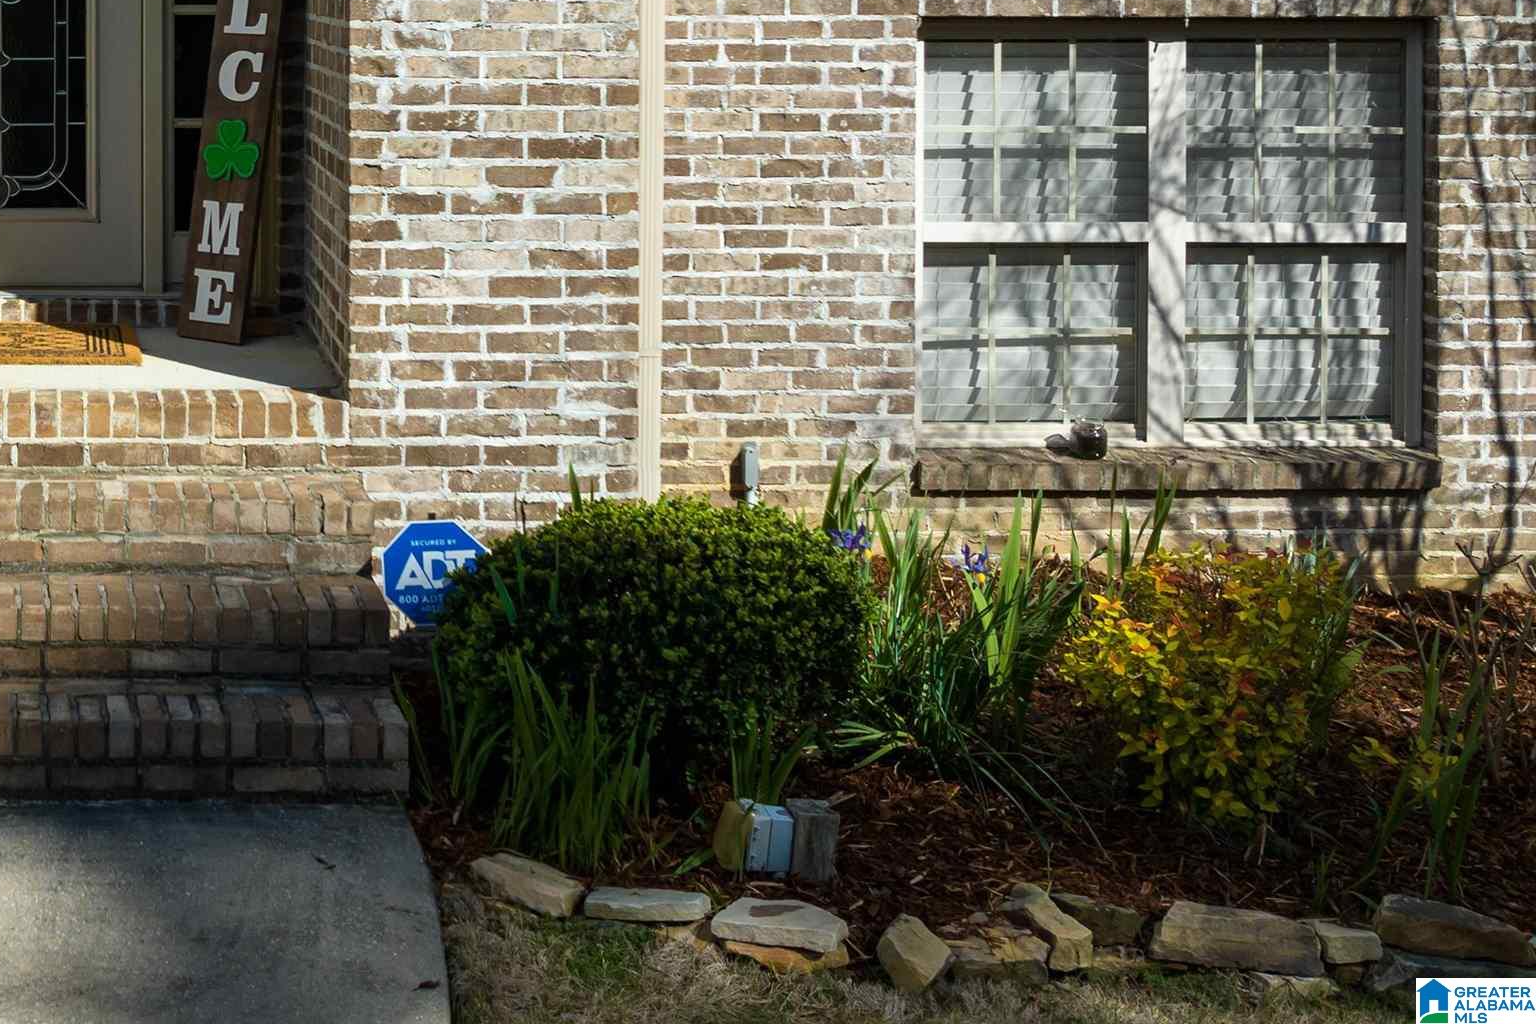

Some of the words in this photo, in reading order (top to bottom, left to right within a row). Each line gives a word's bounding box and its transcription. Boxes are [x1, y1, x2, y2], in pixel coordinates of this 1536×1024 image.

[410, 539, 445, 547] SECURED
[395, 549, 476, 590] ADT
[398, 595, 419, 604] 800
